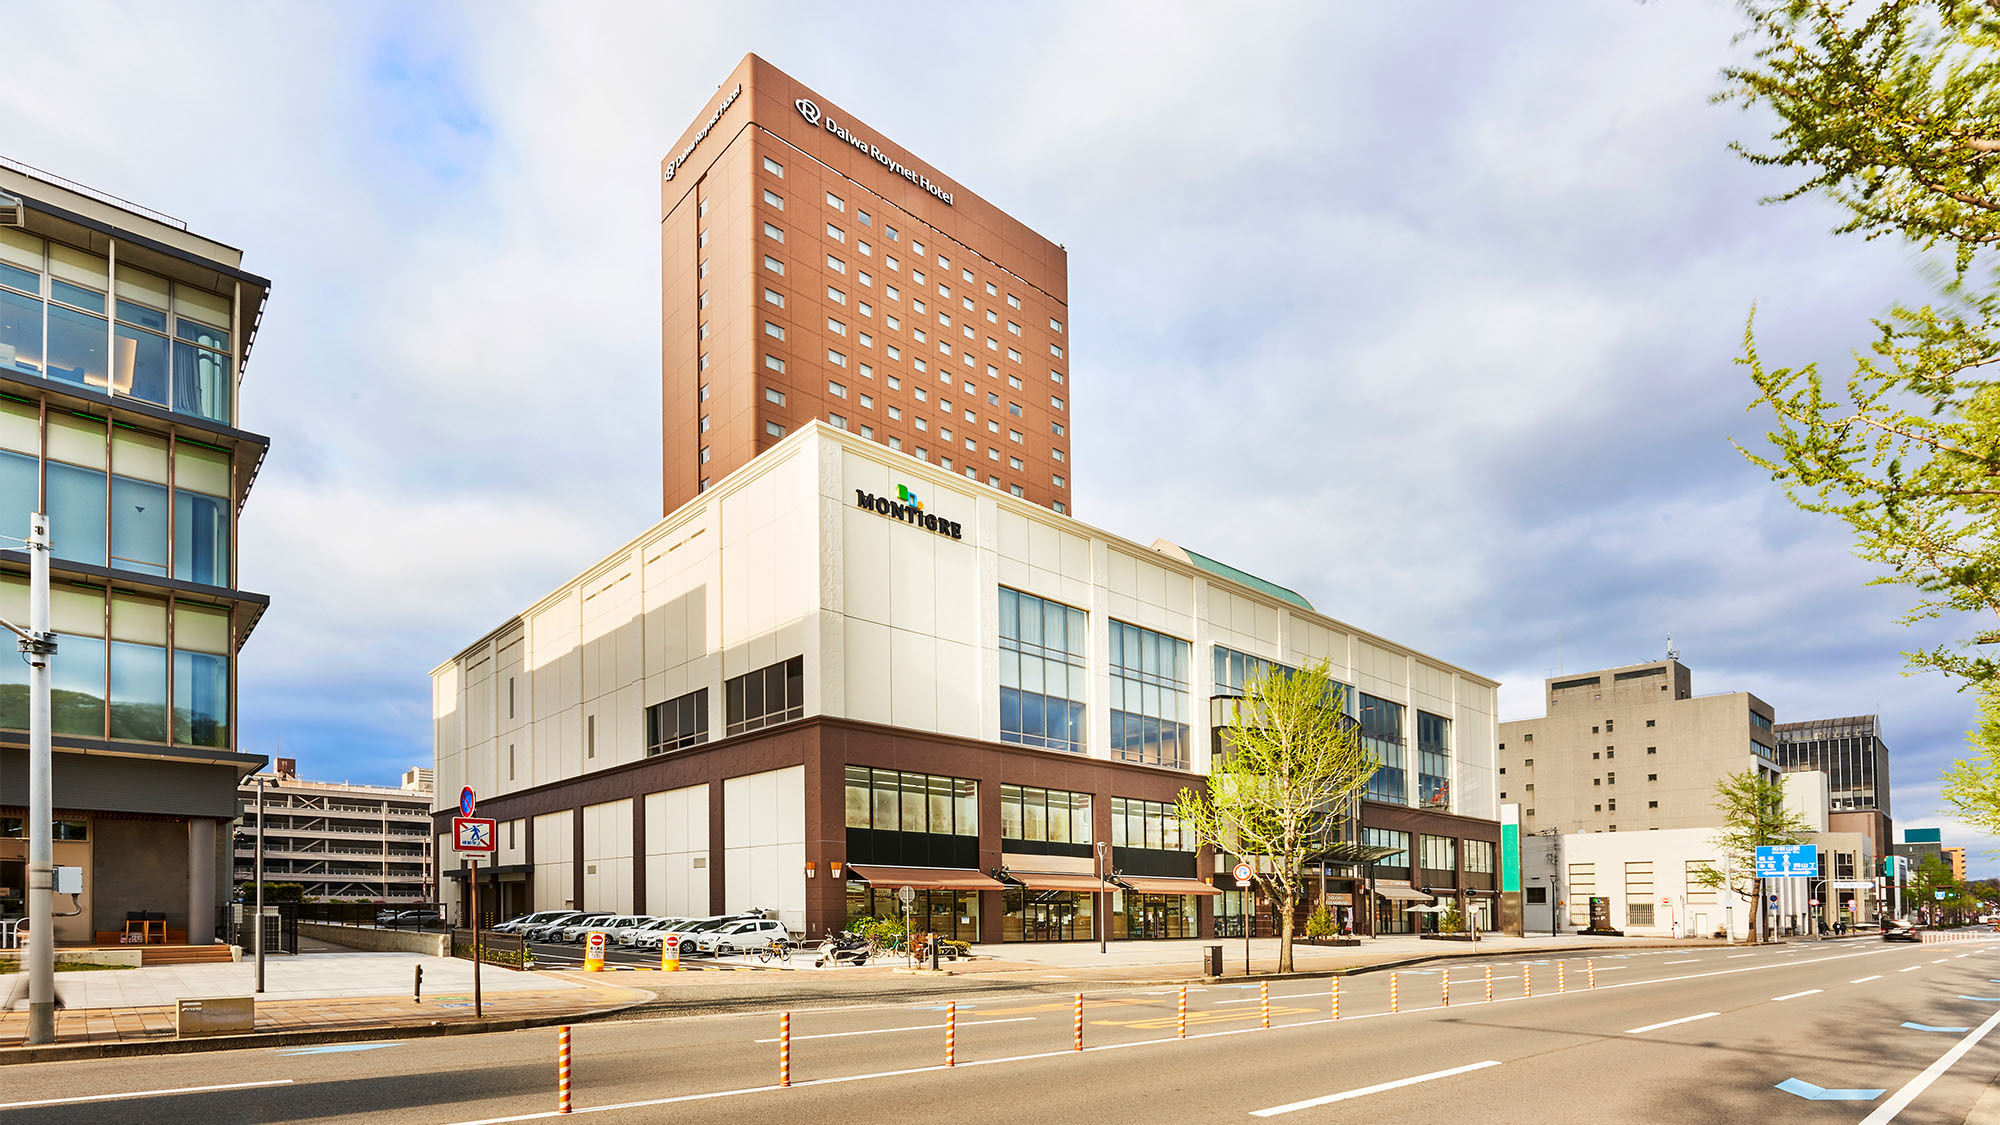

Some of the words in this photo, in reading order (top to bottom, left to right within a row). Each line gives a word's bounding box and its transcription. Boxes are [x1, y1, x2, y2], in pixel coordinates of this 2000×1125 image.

[720, 83, 741, 115] Hotel
[825, 116, 869, 153] Daiwa
[870, 144, 918, 184] Roynet
[919, 175, 953, 206] Hotel
[856, 489, 962, 539] MONTIGRE
